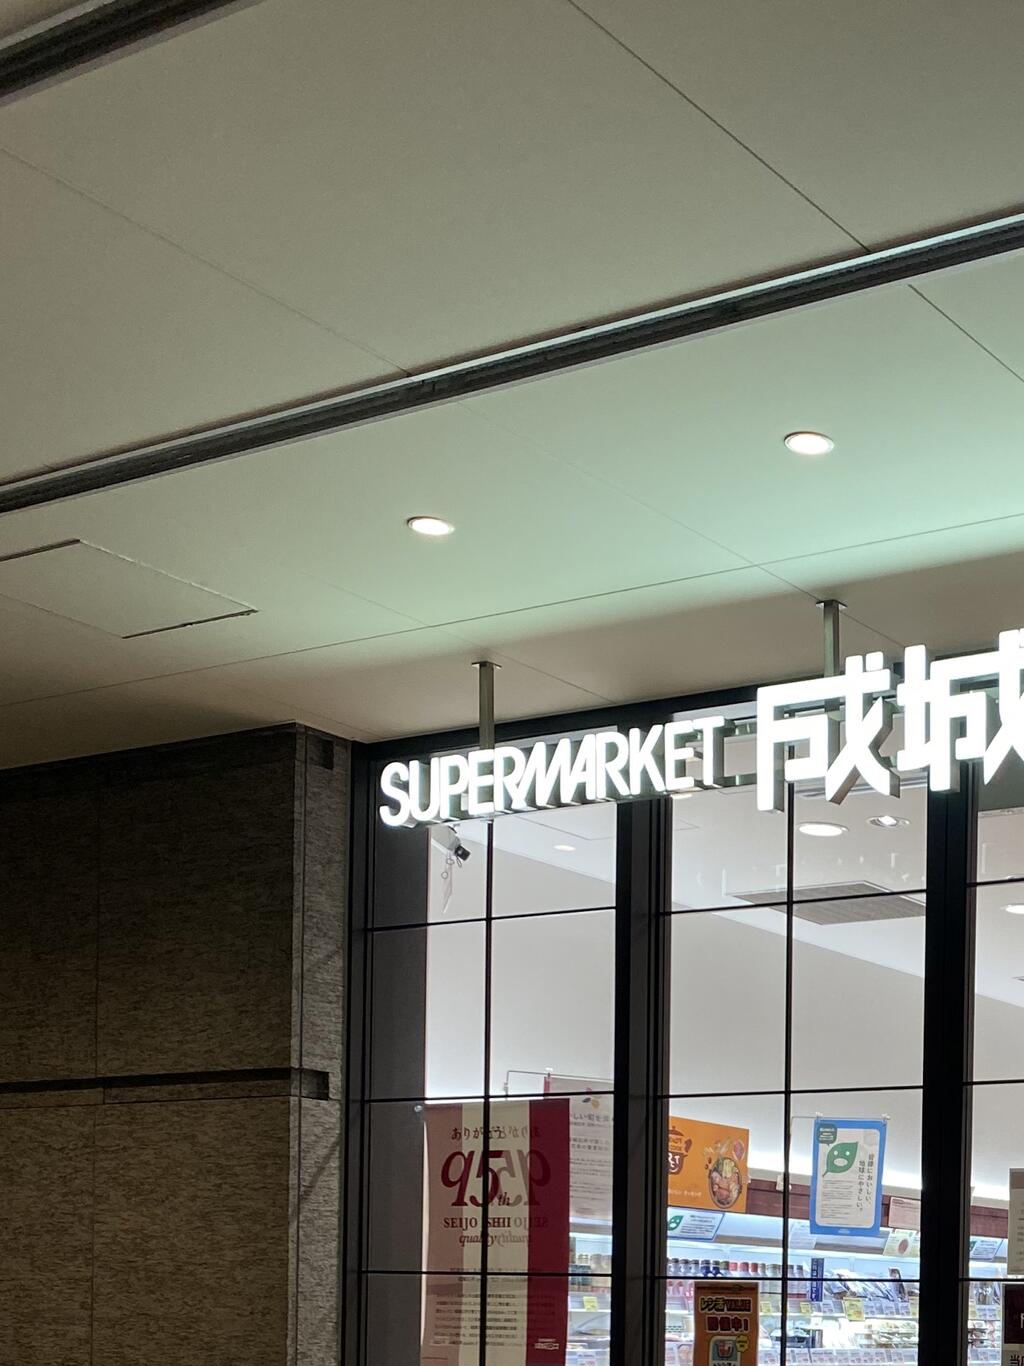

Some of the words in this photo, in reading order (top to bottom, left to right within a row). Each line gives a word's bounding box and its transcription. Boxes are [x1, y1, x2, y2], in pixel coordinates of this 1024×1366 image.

[379, 715, 726, 828] SUPERMARKET
[443, 1216, 478, 1231] SEIJO
[486, 1217, 511, 1228] SHII
[459, 1231, 497, 1247] quay
